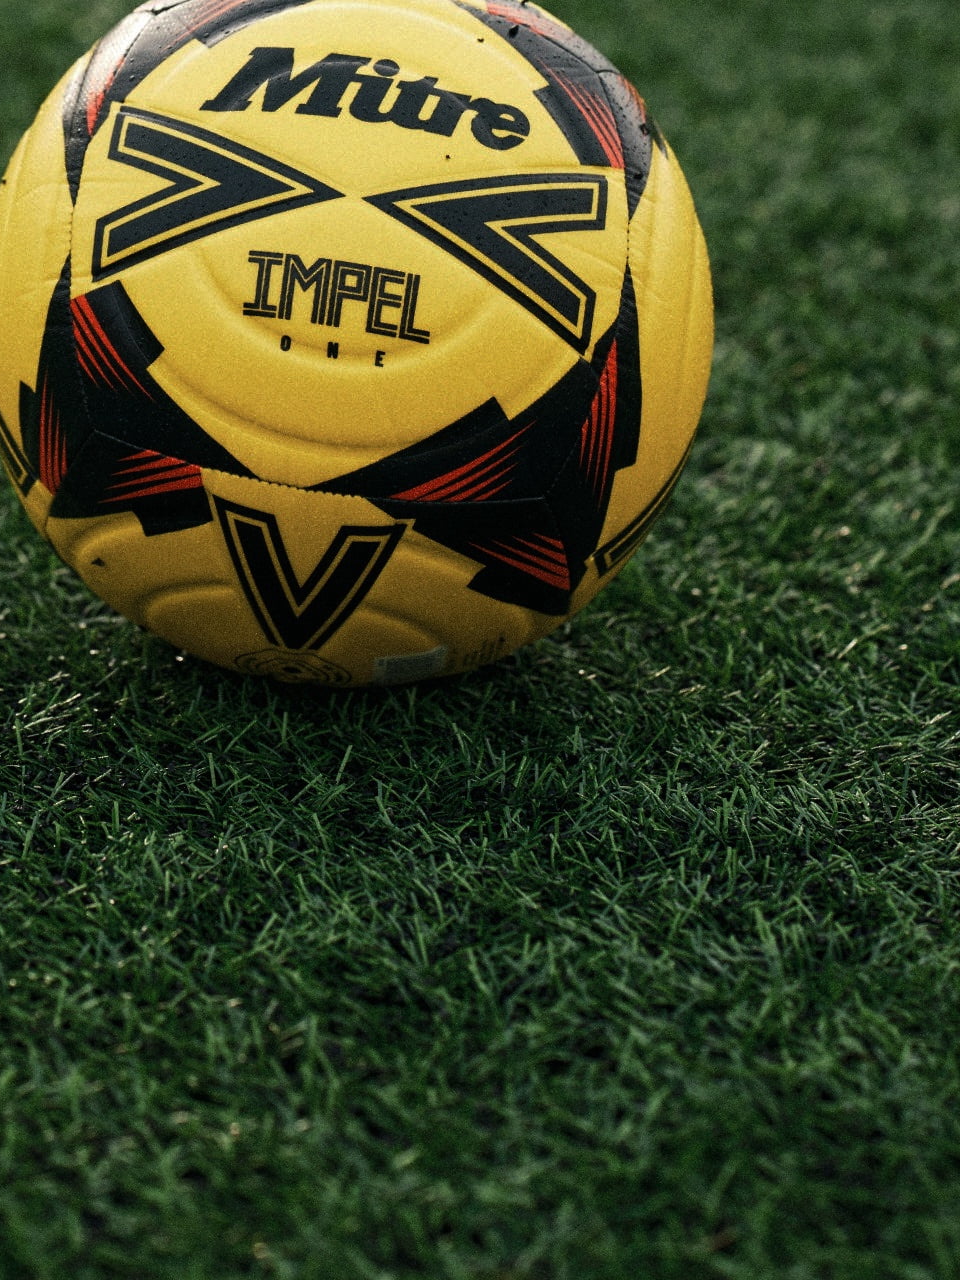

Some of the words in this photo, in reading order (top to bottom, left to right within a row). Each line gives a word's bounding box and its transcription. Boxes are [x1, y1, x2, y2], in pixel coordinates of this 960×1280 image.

[199, 47, 530, 150] Mitre
[243, 250, 430, 344] IMPEL
[280, 335, 386, 367] ONE
